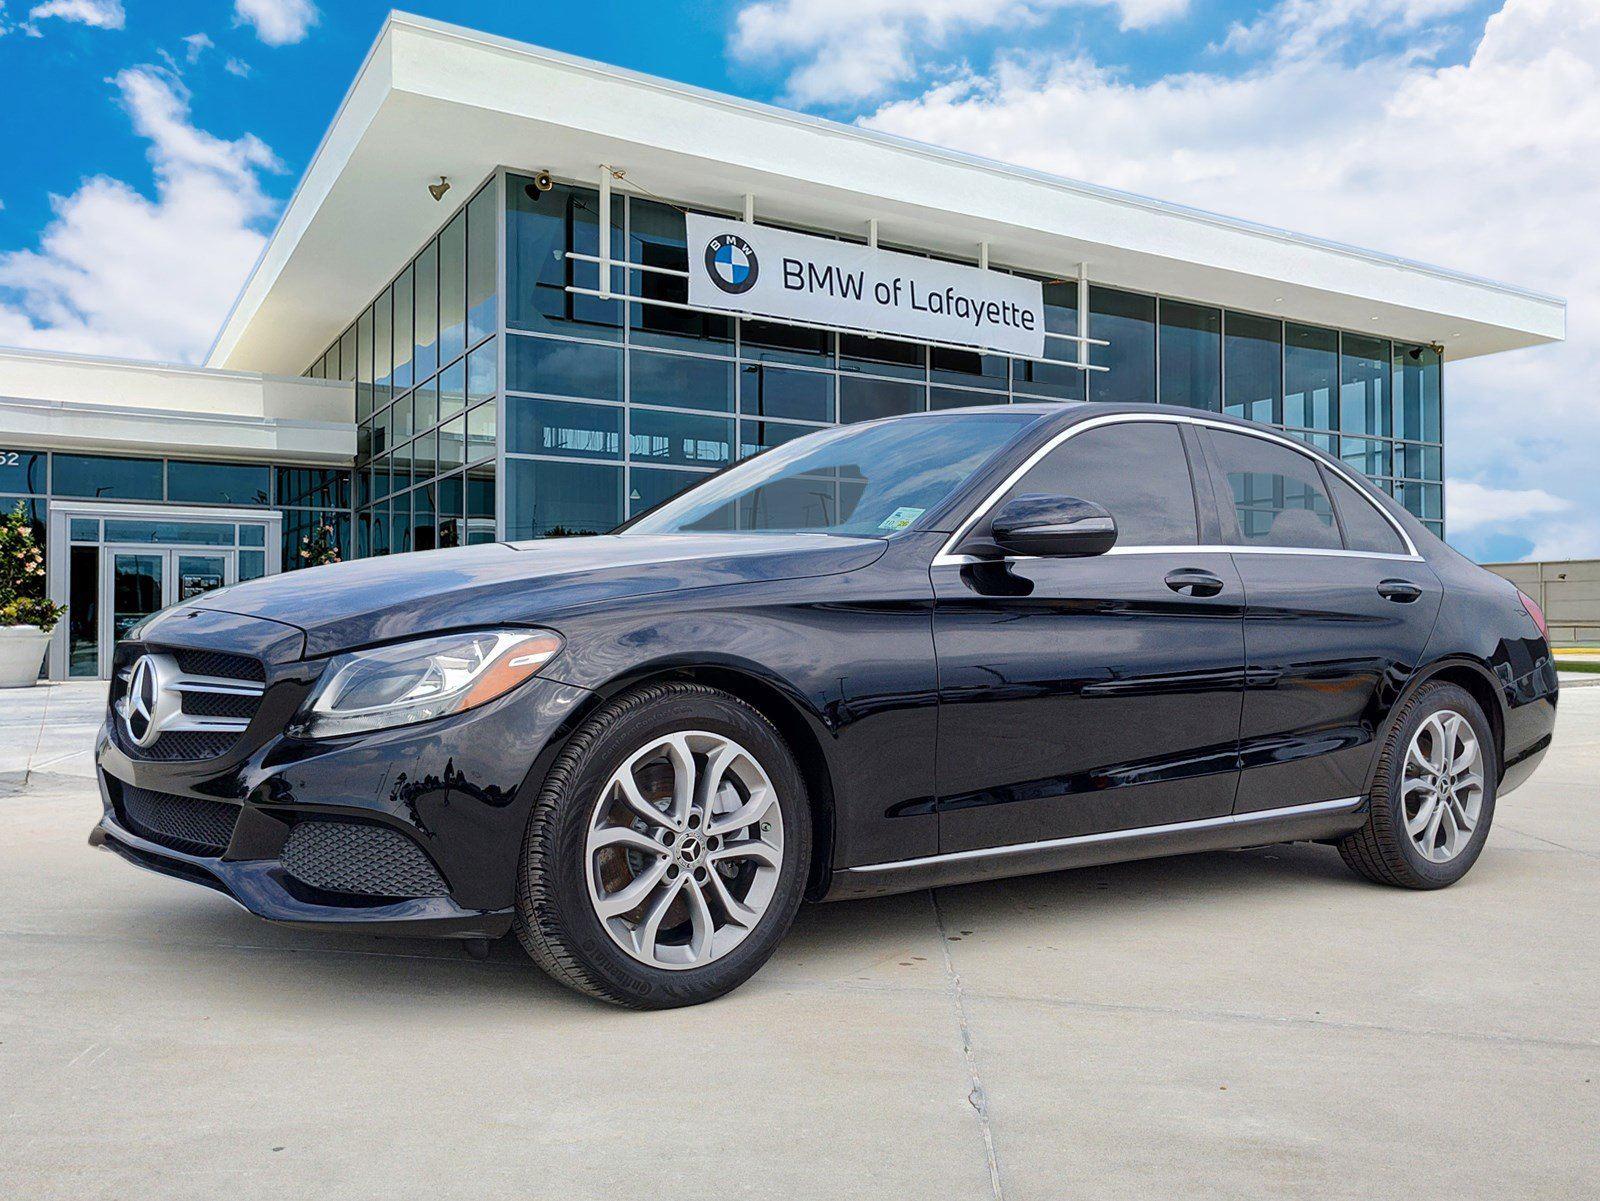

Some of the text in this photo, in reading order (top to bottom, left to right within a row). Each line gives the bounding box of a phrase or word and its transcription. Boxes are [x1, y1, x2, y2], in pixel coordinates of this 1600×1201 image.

[710, 235, 753, 256] BMW
[783, 258, 1035, 331] BMW of Lafayette
